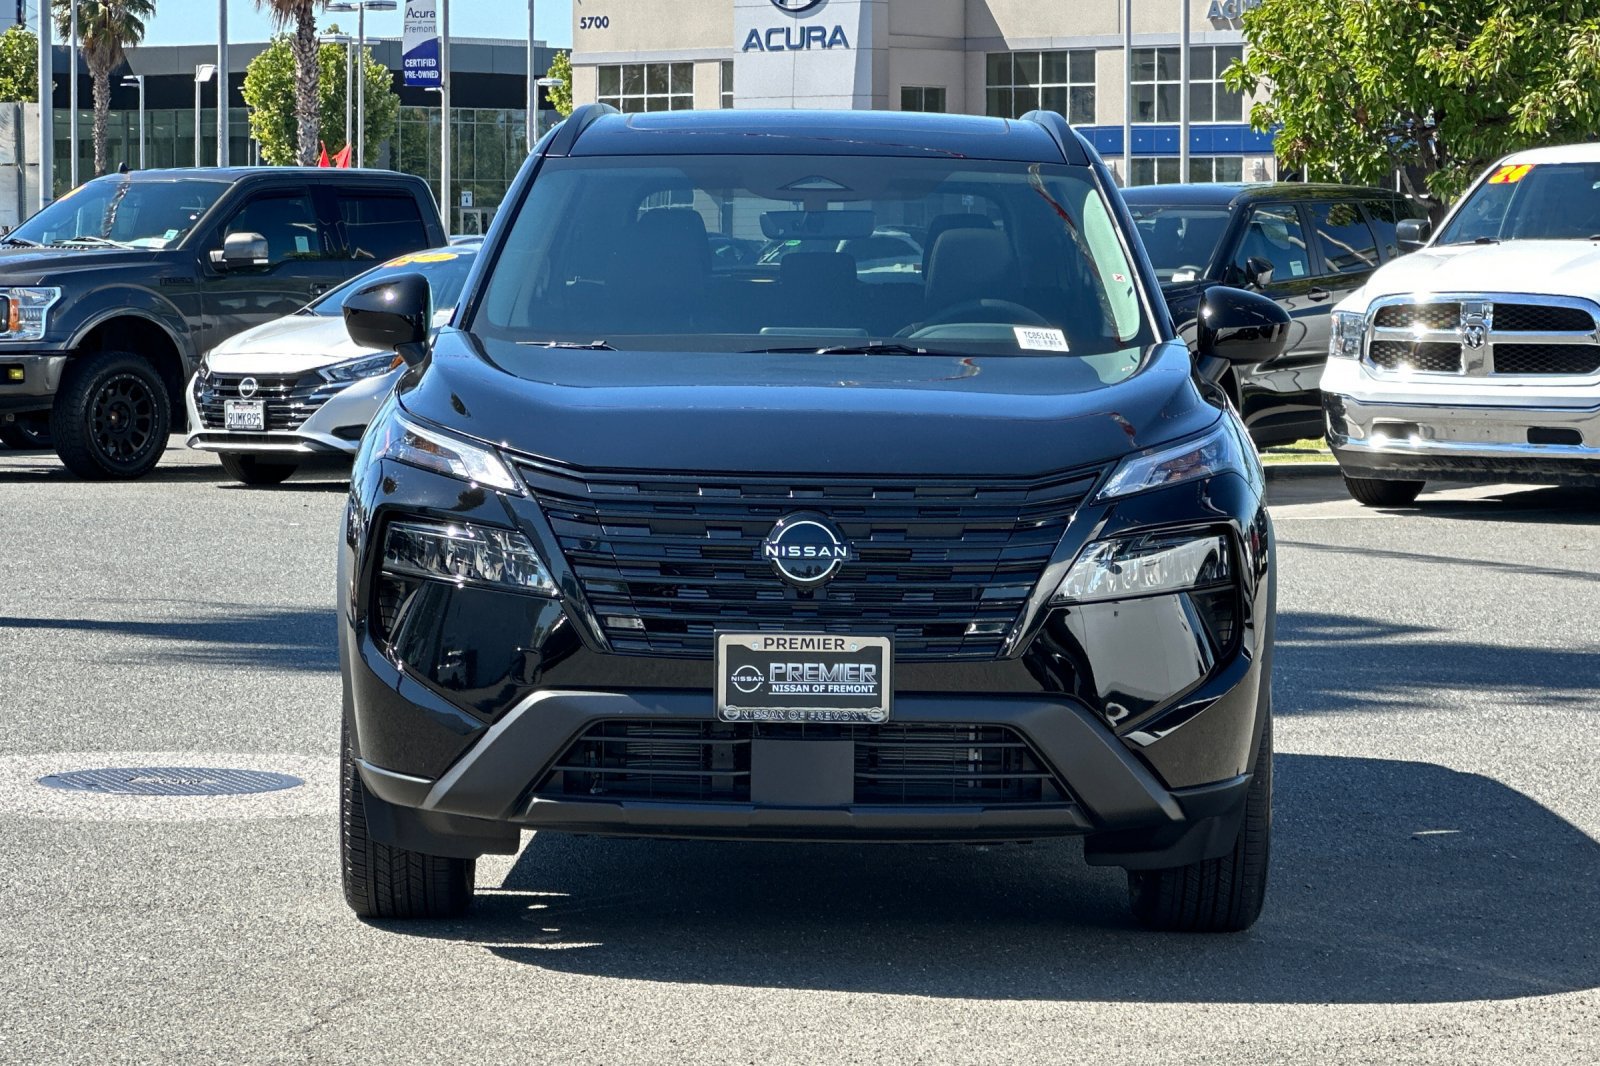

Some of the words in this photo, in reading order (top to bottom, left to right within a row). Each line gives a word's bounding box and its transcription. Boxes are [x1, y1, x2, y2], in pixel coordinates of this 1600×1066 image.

[406, 7, 436, 19] Acura
[580, 16, 610, 29] 5700
[404, 25, 436, 33] Fremont
[742, 25, 851, 52] ACURA
[405, 58, 436, 67] CERTIFIED
[404, 70, 439, 79] PRE-OWNED
[765, 545, 847, 557] NISSAN
[763, 637, 845, 650] PREMIER
[769, 662, 876, 682] PREMIER
[772, 684, 812, 693] NISSAN
[812, 684, 826, 693] OF
[828, 684, 875, 693] FREMONT
[741, 709, 786, 720] NISSAN
[788, 710, 805, 721] OF
[808, 710, 867, 721] FREMONT
